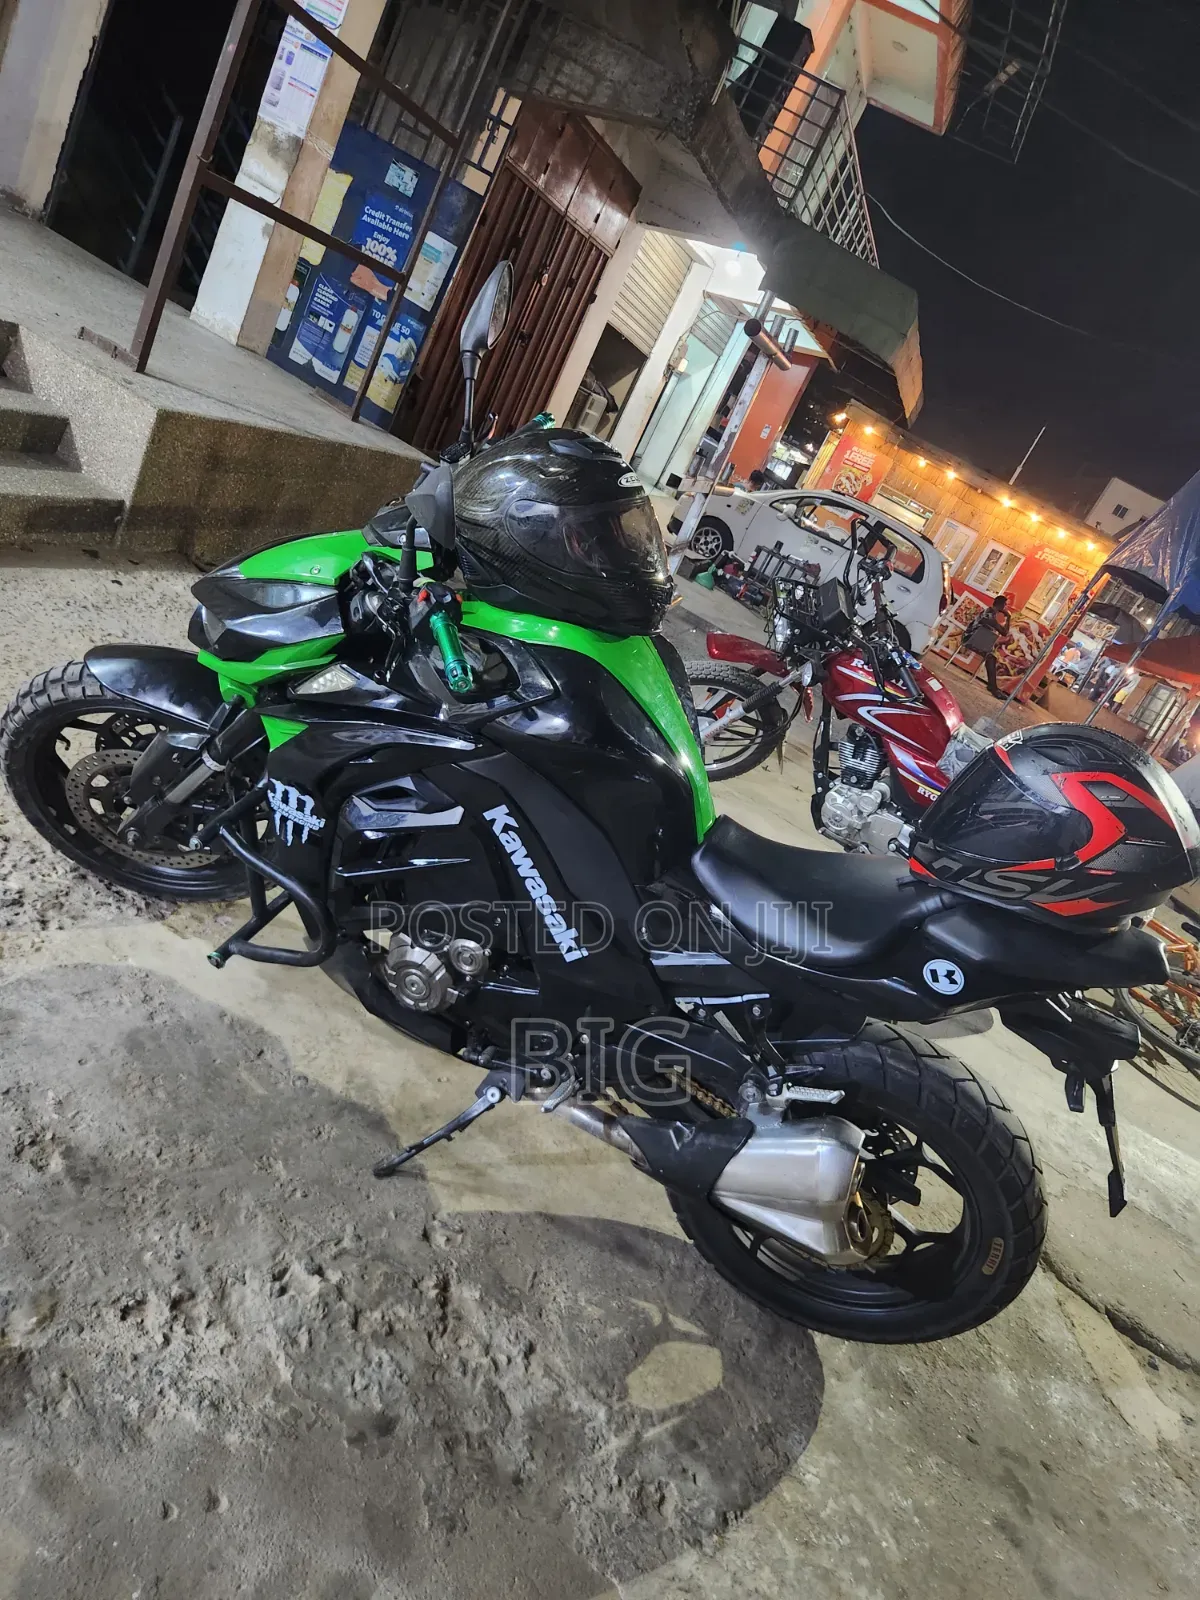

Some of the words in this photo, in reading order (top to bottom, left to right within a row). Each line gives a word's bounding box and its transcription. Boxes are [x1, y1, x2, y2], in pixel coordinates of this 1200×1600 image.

[361, 213, 393, 233] Available
[392, 226, 410, 241] Here
[364, 205, 385, 221] Credit
[385, 214, 413, 232] Transfer
[365, 237, 398, 262] 100%
[372, 231, 391, 245] Enjoy
[267, 789, 327, 829] Kawasaki
[482, 803, 590, 964] Kawasaki
